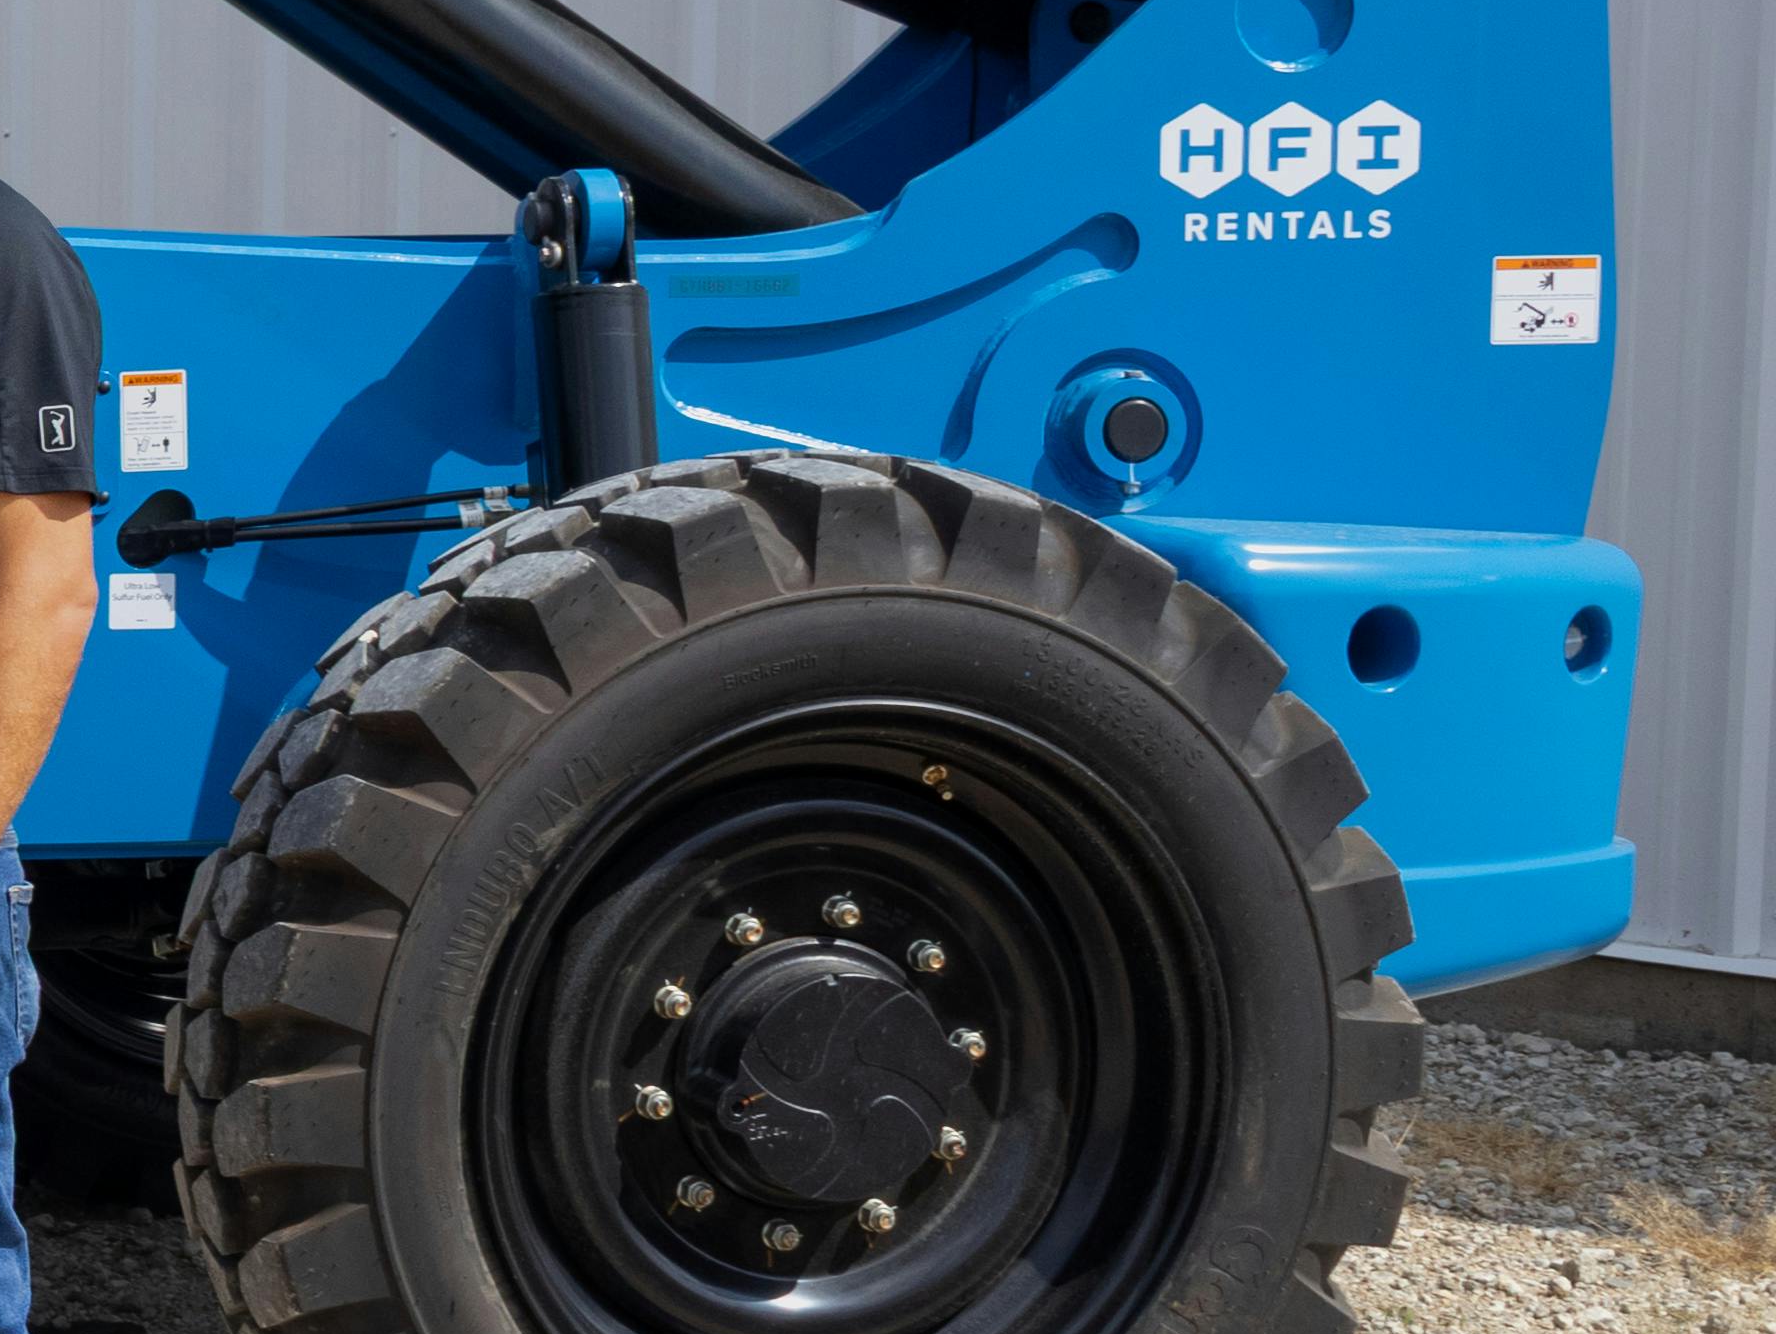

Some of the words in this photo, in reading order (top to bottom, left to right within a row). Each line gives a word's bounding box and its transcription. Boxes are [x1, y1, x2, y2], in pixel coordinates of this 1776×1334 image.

[1184, 209, 1392, 243] RENTALS
[134, 374, 179, 385] WARNING
[136, 593, 153, 601] Fuel
[154, 593, 173, 603] Only
